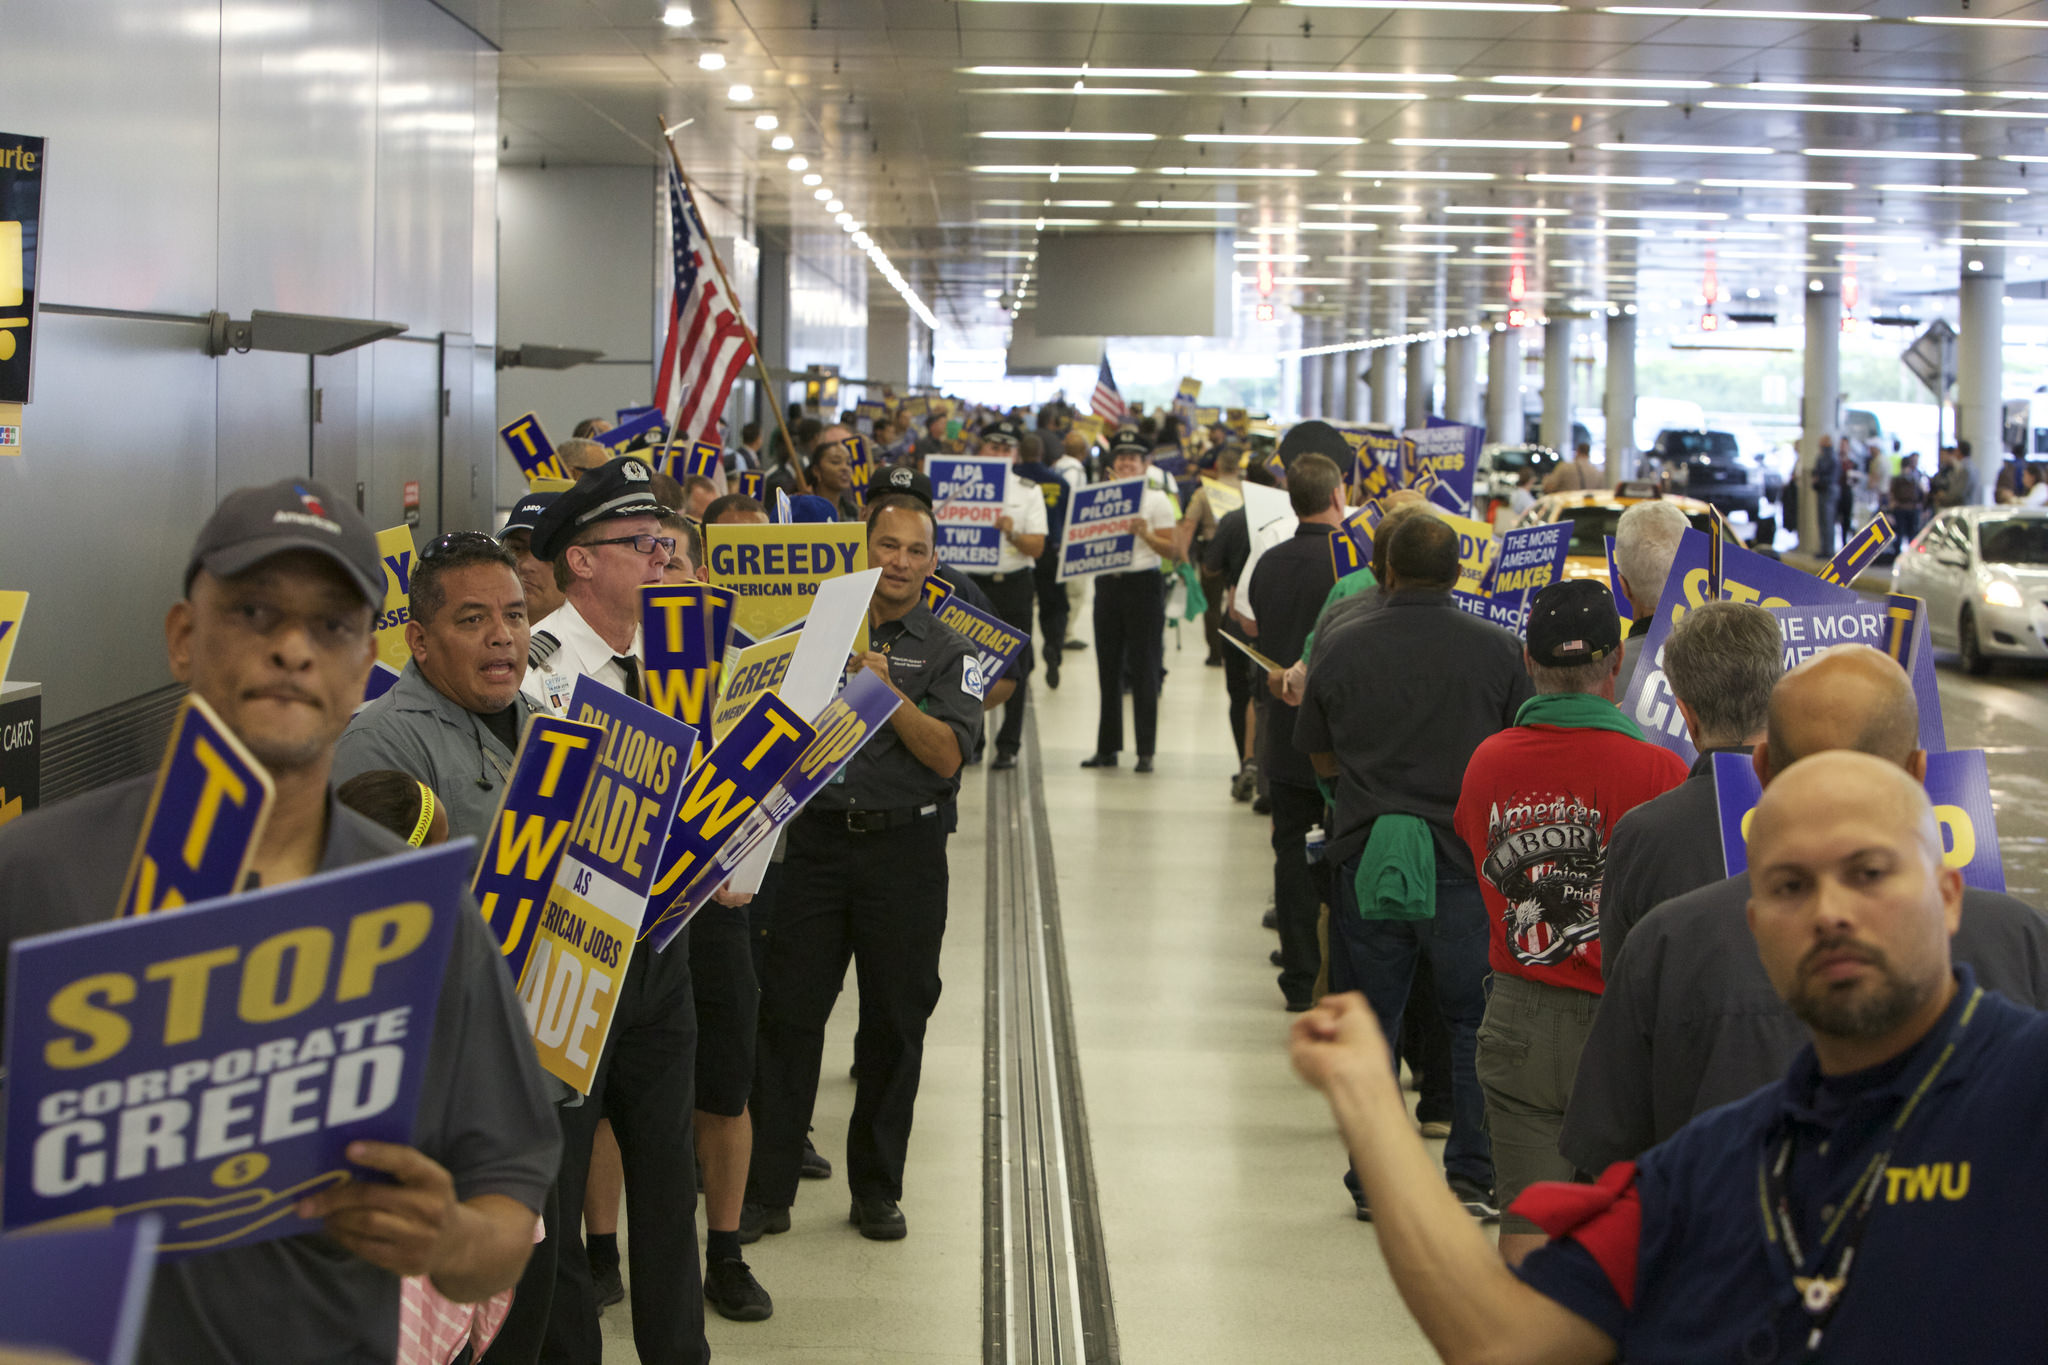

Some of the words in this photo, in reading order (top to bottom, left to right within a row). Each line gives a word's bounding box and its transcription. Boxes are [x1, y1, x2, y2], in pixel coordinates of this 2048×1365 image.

[952, 464, 984, 482] APA
[937, 482, 996, 501] PILOTS
[1094, 487, 1122, 504] APA
[932, 505, 1003, 521] UPPORT
[1080, 499, 1132, 522] PILOTS
[944, 528, 981, 544] TWU
[1084, 540, 1118, 555] TWU
[1507, 536, 1527, 550] THE
[1527, 528, 1561, 547] MORE
[711, 541, 860, 576] GREEDY
[936, 546, 998, 564] ORKERS
[1063, 549, 1132, 575] WORKERS
[1501, 546, 1557, 569] AMERICAN
[798, 583, 823, 596] BO
[1496, 562, 1553, 594] MAKE$
[376, 605, 411, 631] SSE
[939, 605, 1021, 657] CONTRACT
[725, 652, 793, 702] GREE
[3, 718, 34, 751] CARTS
[1487, 797, 1601, 846] American
[480, 729, 590, 957] TWU
[1493, 826, 1586, 871] LABOR
[573, 867, 592, 896] AS
[1537, 864, 1588, 883] Union
[1563, 885, 1600, 904] Pride
[583, 925, 622, 969] JOBS
[44, 901, 433, 1070] STOP
[38, 1005, 413, 1126] CORPORATE
[32, 1043, 405, 1198] GREED
[1884, 1161, 1971, 1205] TWU
